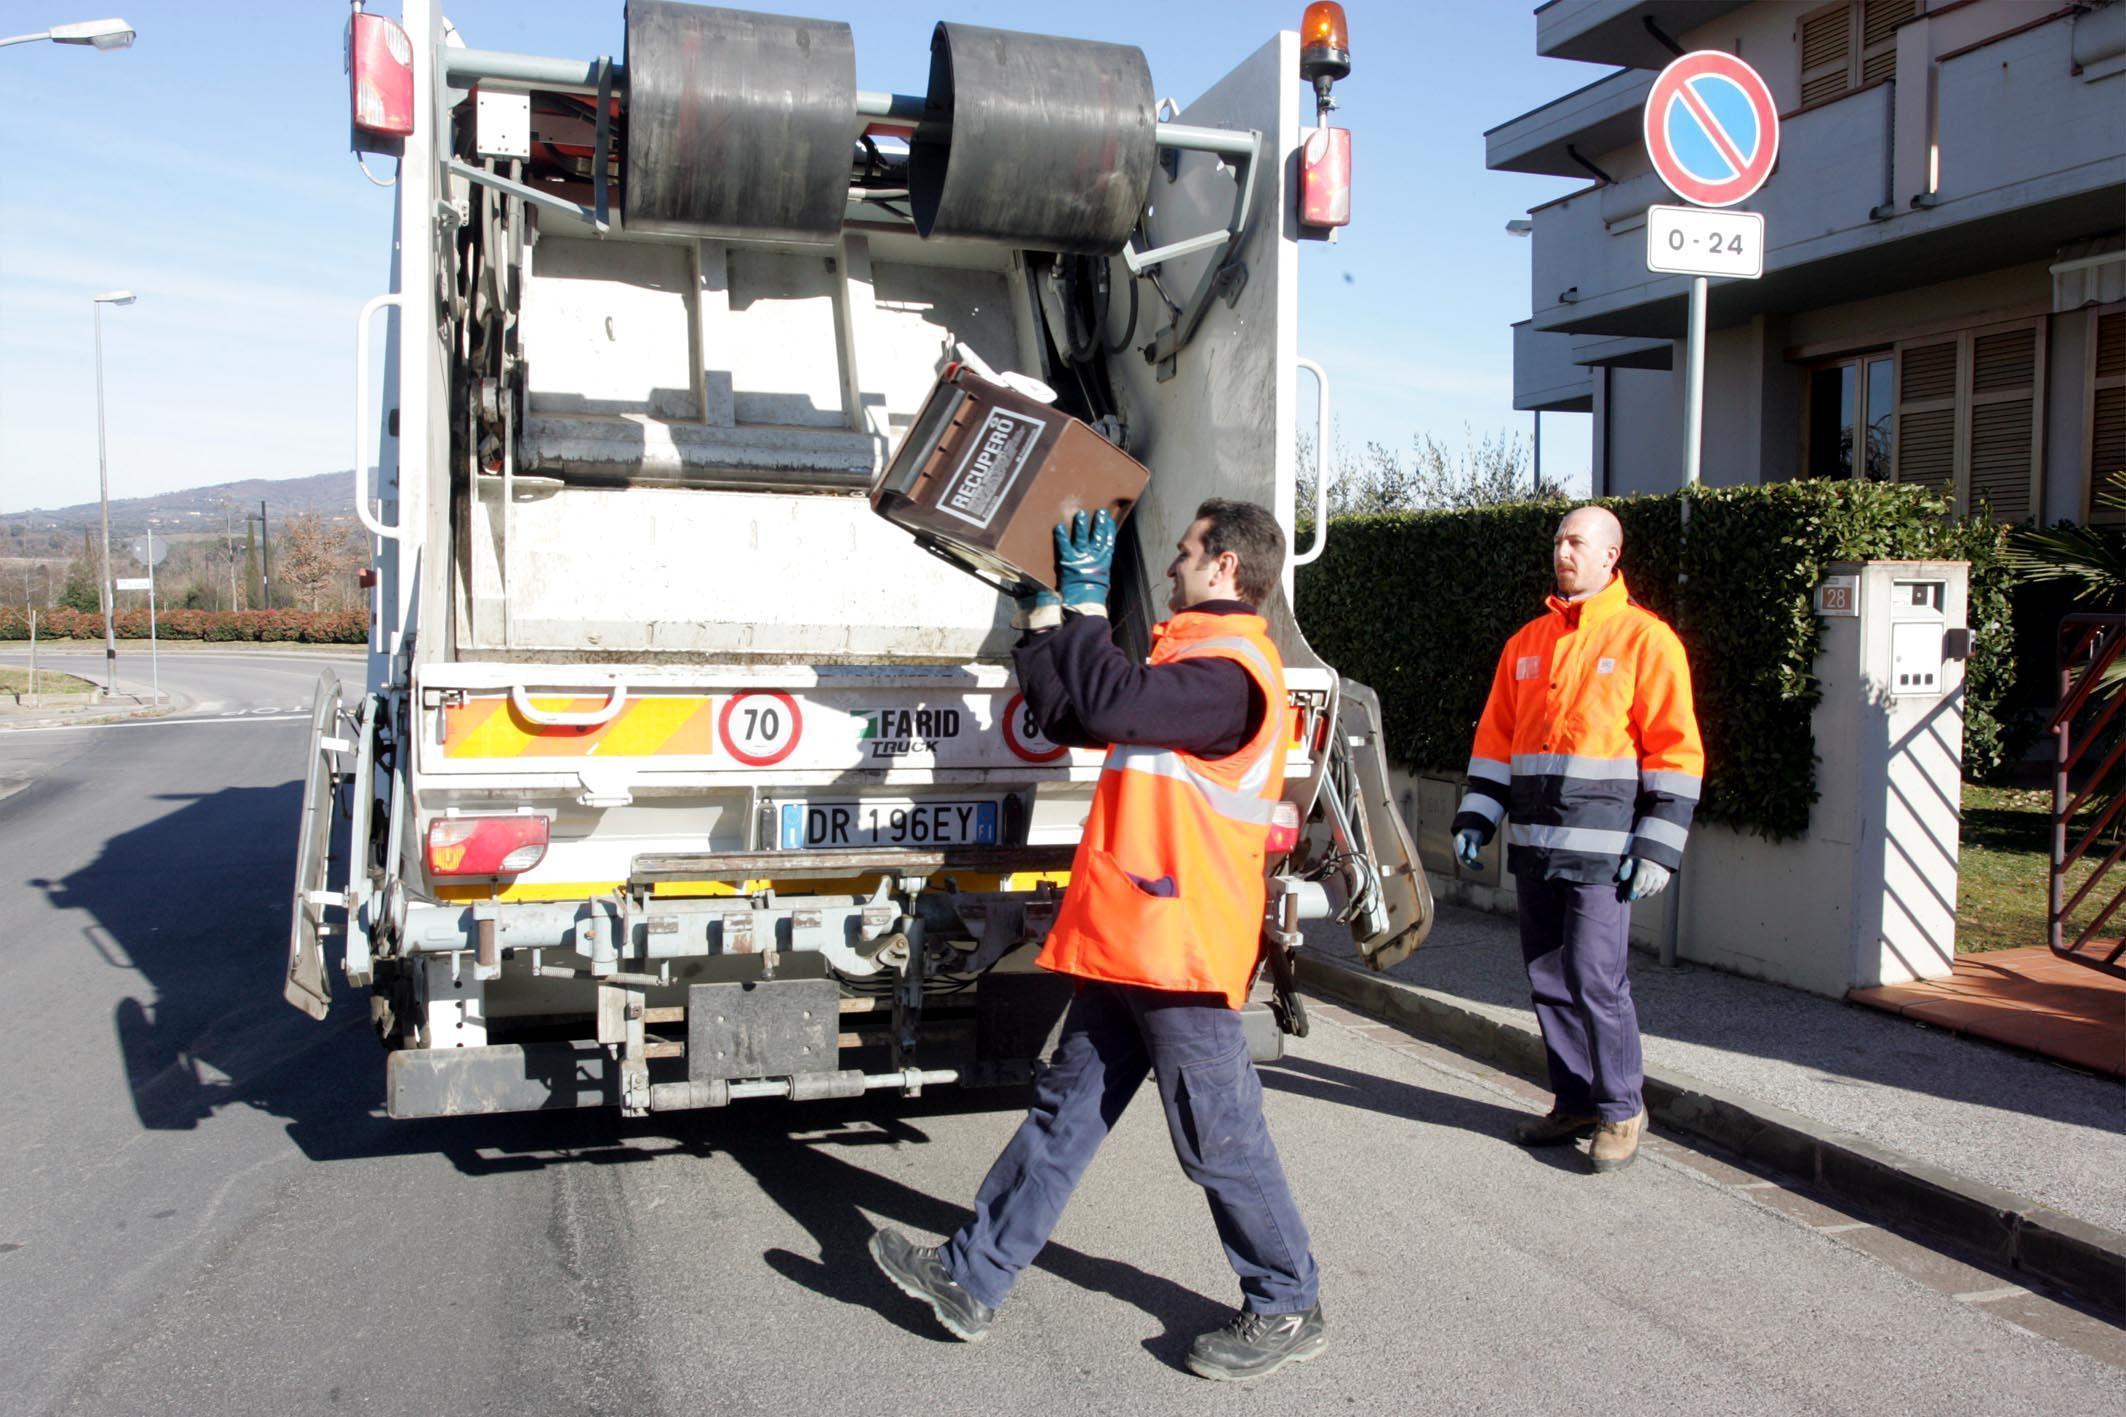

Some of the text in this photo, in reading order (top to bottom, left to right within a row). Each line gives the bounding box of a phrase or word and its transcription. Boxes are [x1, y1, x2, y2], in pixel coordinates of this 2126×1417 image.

[1668, 229, 1684, 251] 0
[1709, 232, 1743, 255] 24
[951, 418, 1014, 509] RECUPERO
[1827, 588, 1845, 608] 28
[744, 707, 779, 741] 70
[881, 709, 960, 739] FARID
[872, 740, 940, 758] TRUCK
[808, 808, 850, 844] DR
